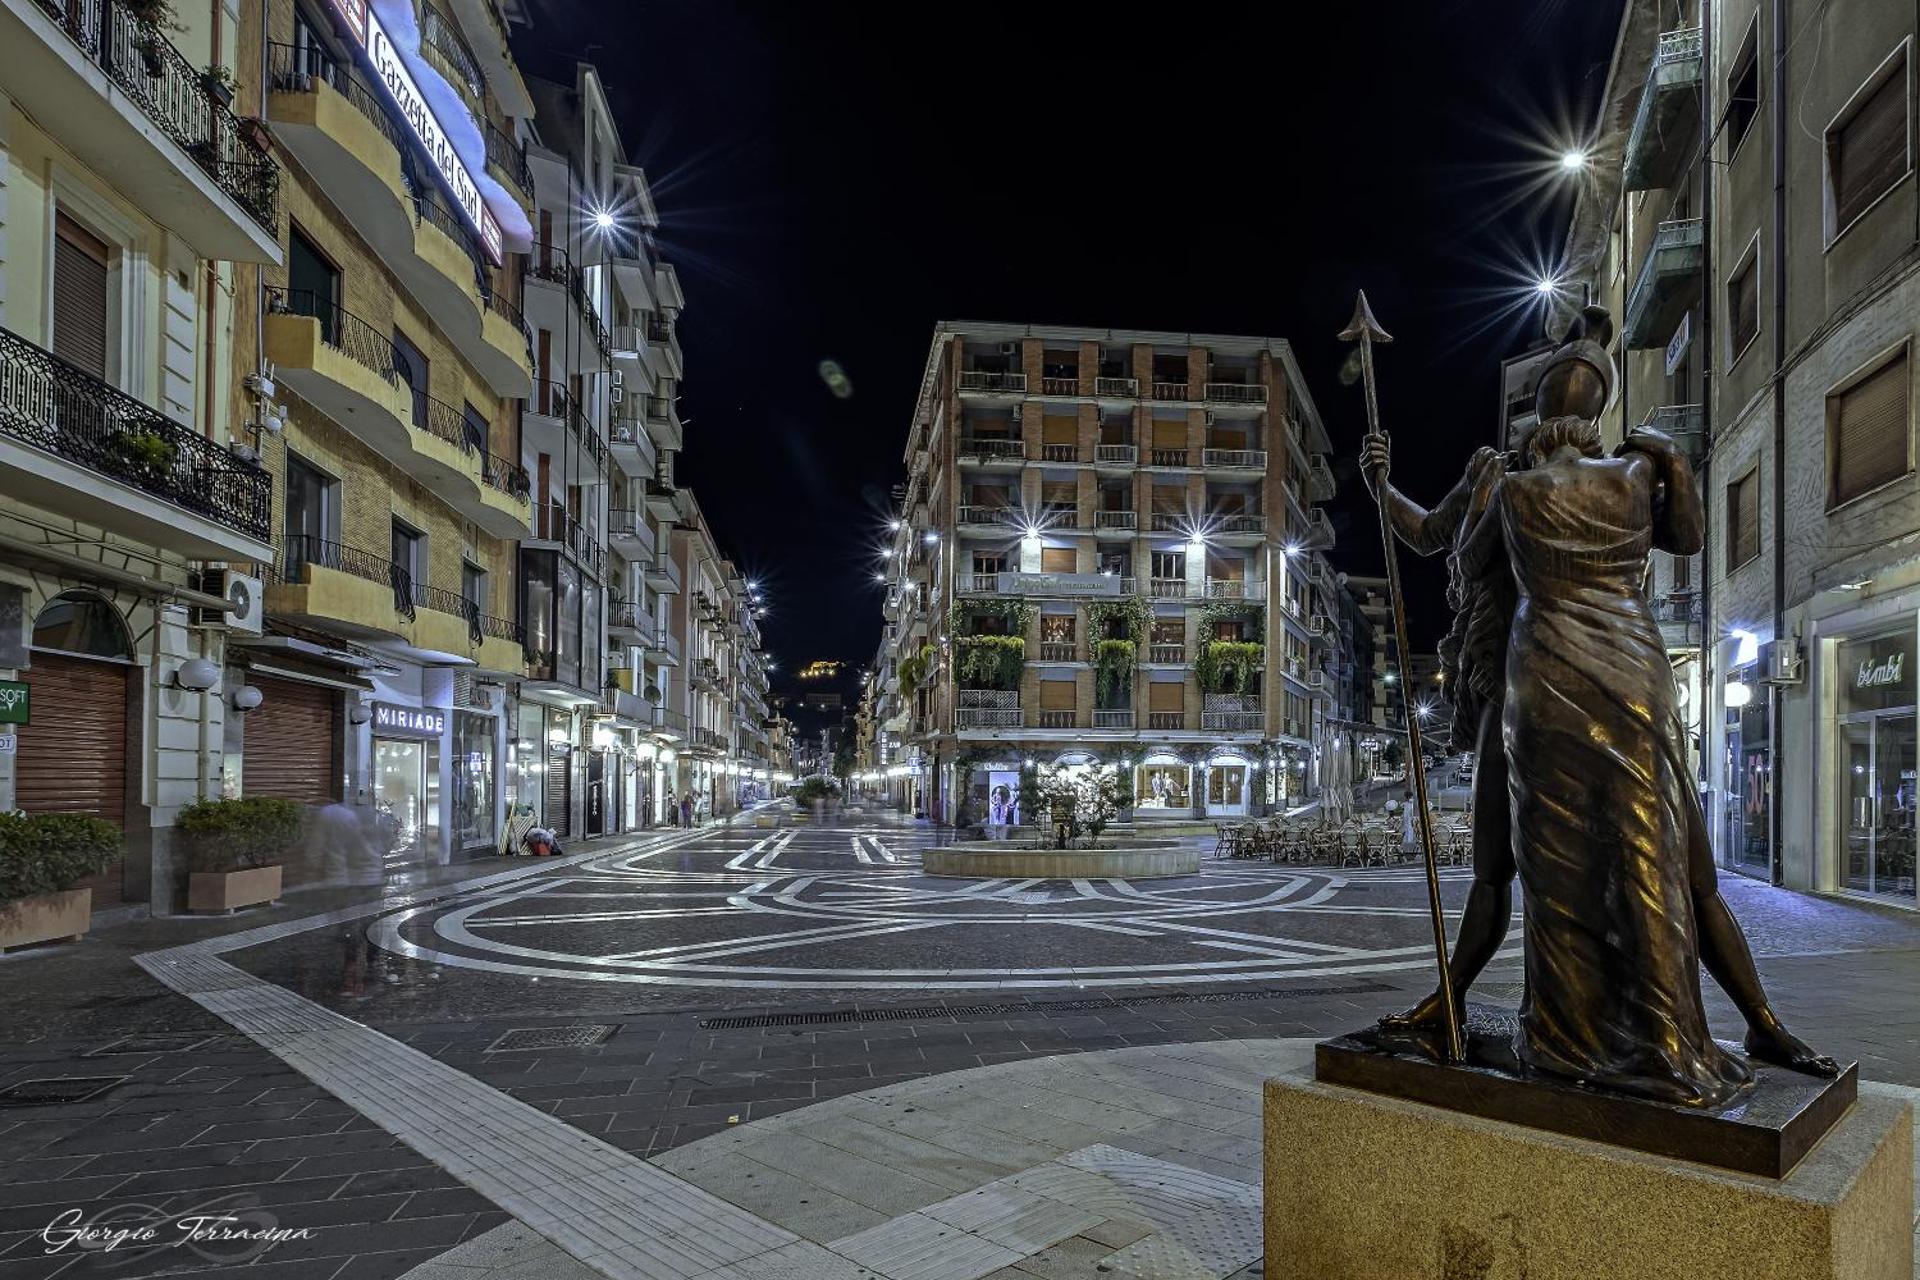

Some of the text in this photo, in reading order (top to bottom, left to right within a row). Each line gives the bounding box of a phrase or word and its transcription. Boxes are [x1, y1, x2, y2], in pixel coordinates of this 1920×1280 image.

[374, 31, 478, 224] Gazzetta del Sud
[1856, 652, 1905, 688] bimbi
[378, 707, 444, 733] MIRIADE
